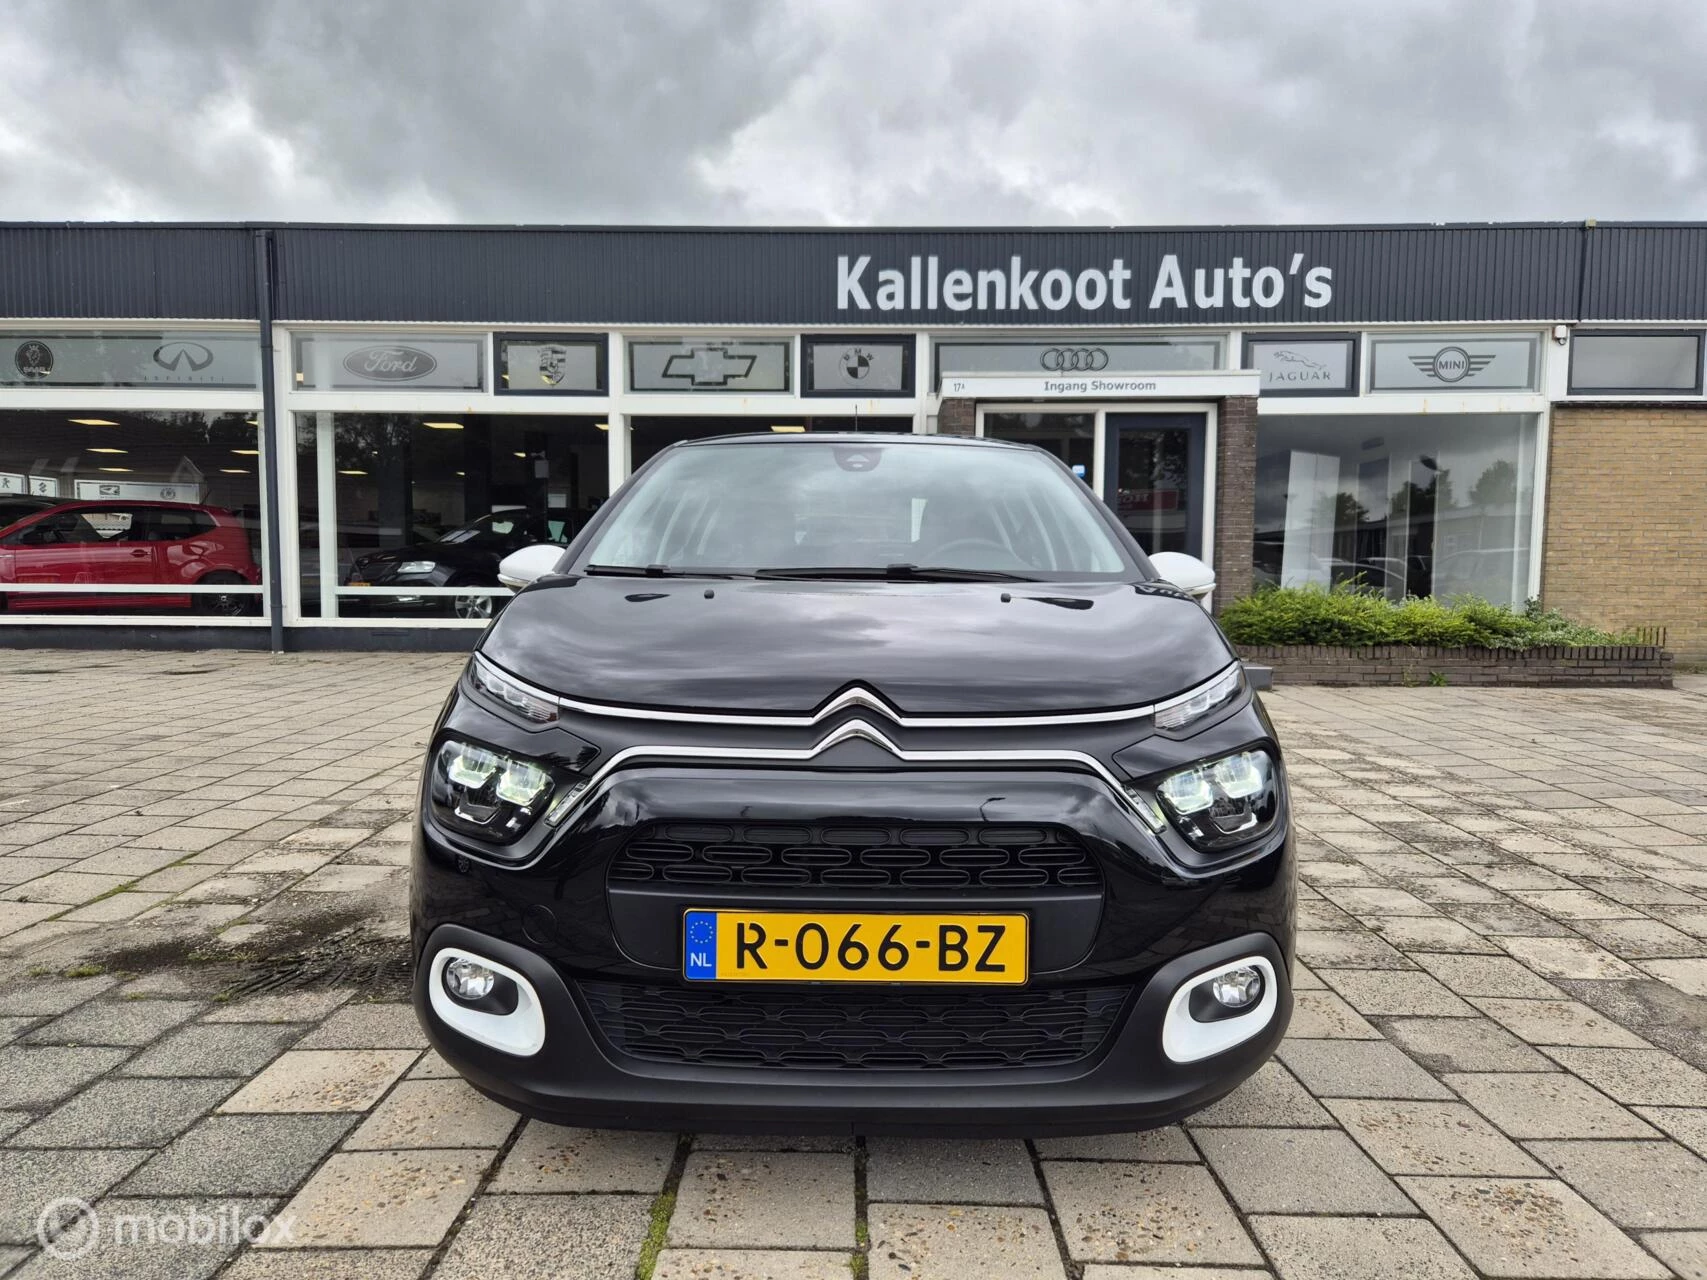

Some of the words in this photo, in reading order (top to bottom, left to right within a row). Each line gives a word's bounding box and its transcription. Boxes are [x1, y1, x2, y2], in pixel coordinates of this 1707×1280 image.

[837, 255, 1131, 310] Kallenkoot
[1149, 253, 1332, 308] Auto's
[364, 350, 418, 372] Ford
[1438, 360, 1465, 370] MINI
[1269, 371, 1331, 382] JAGUAR
[1044, 381, 1087, 393] Ingang
[1091, 380, 1156, 391] Showroom
[736, 922, 1006, 973] R-066-BZ
[690, 952, 712, 967] NL
